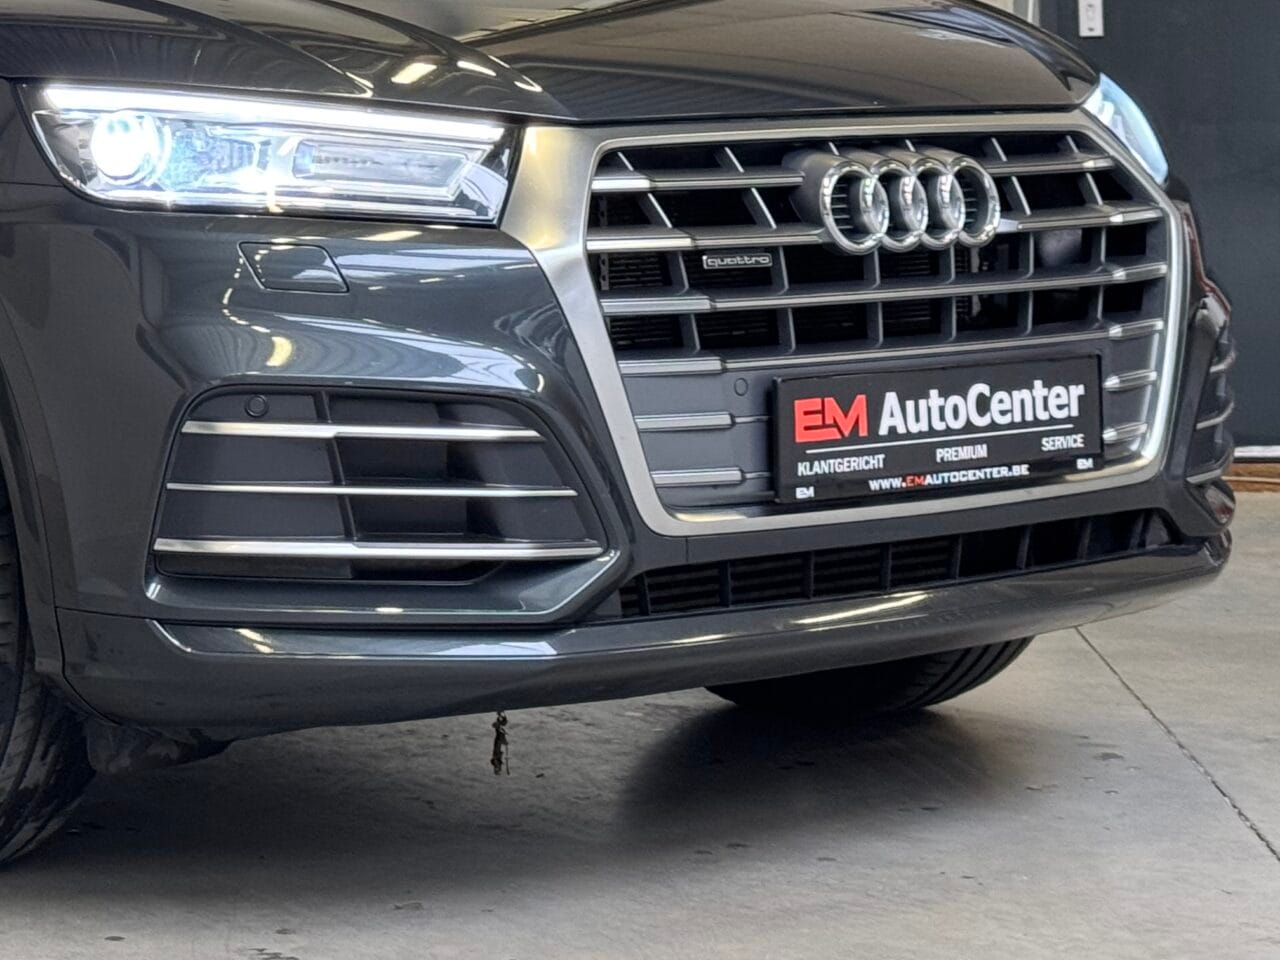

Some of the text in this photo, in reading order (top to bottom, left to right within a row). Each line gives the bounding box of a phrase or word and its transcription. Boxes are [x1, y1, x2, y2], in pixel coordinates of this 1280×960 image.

[707, 255, 770, 269] quattro
[794, 380, 1085, 443] EM AutoCenter
[797, 433, 1085, 477] KLANTGERICHT PREMIUM SERVICE
